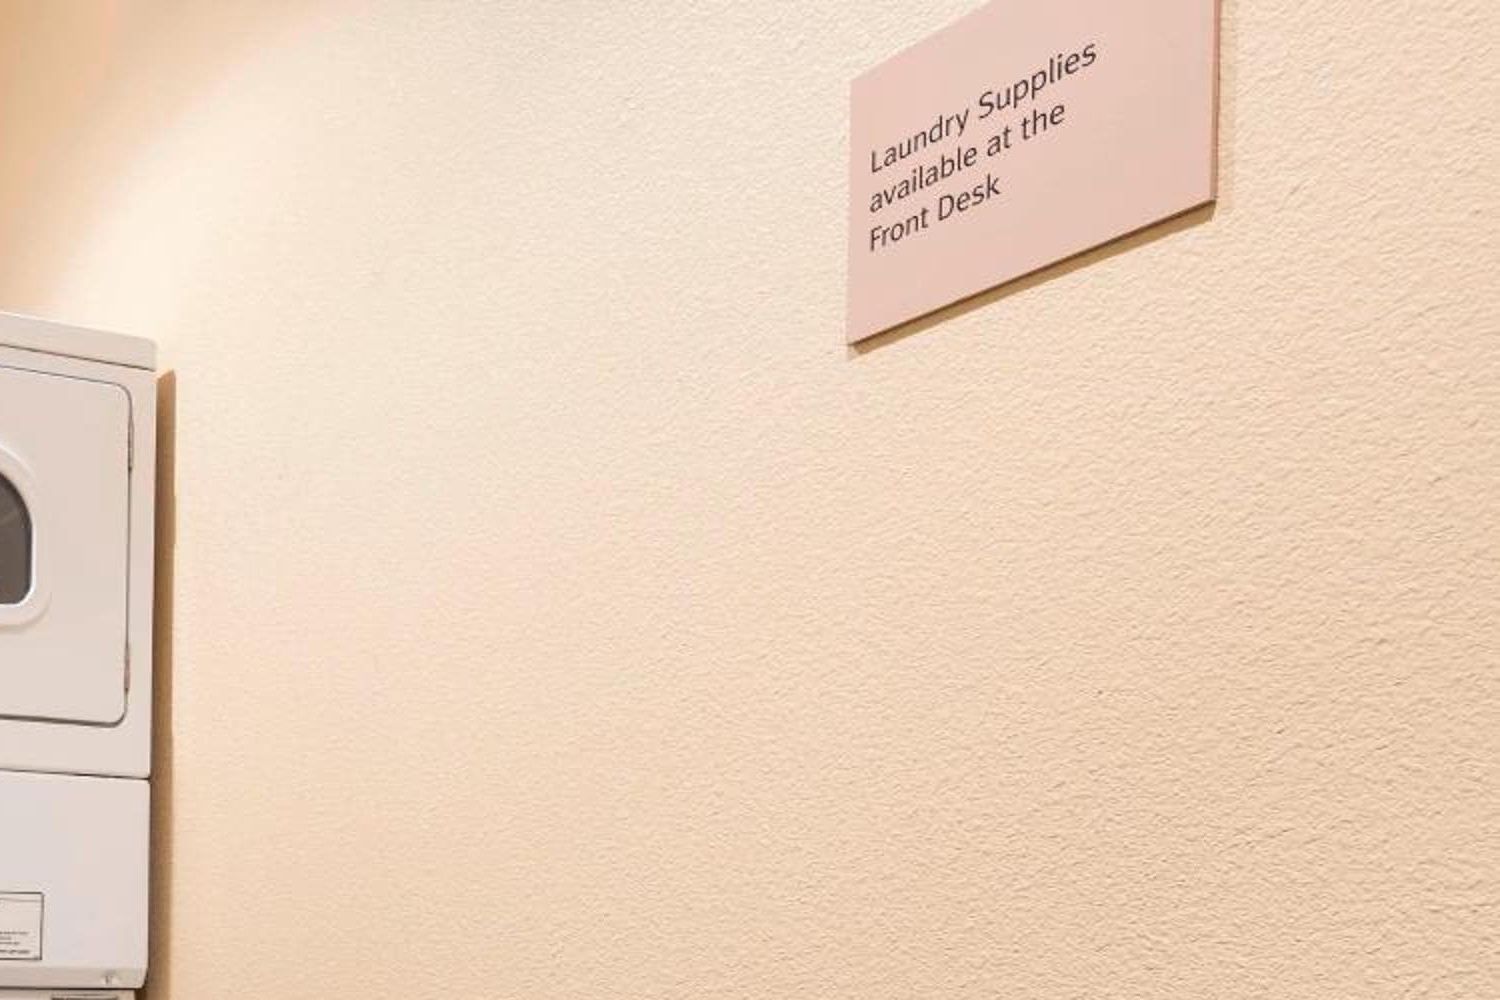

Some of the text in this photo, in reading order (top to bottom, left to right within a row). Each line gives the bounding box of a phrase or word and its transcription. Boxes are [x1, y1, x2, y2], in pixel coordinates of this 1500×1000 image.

[869, 104, 1065, 213] available at the
[871, 43, 1097, 174] Laundry Supplies
[870, 174, 1001, 252] Front Desk
